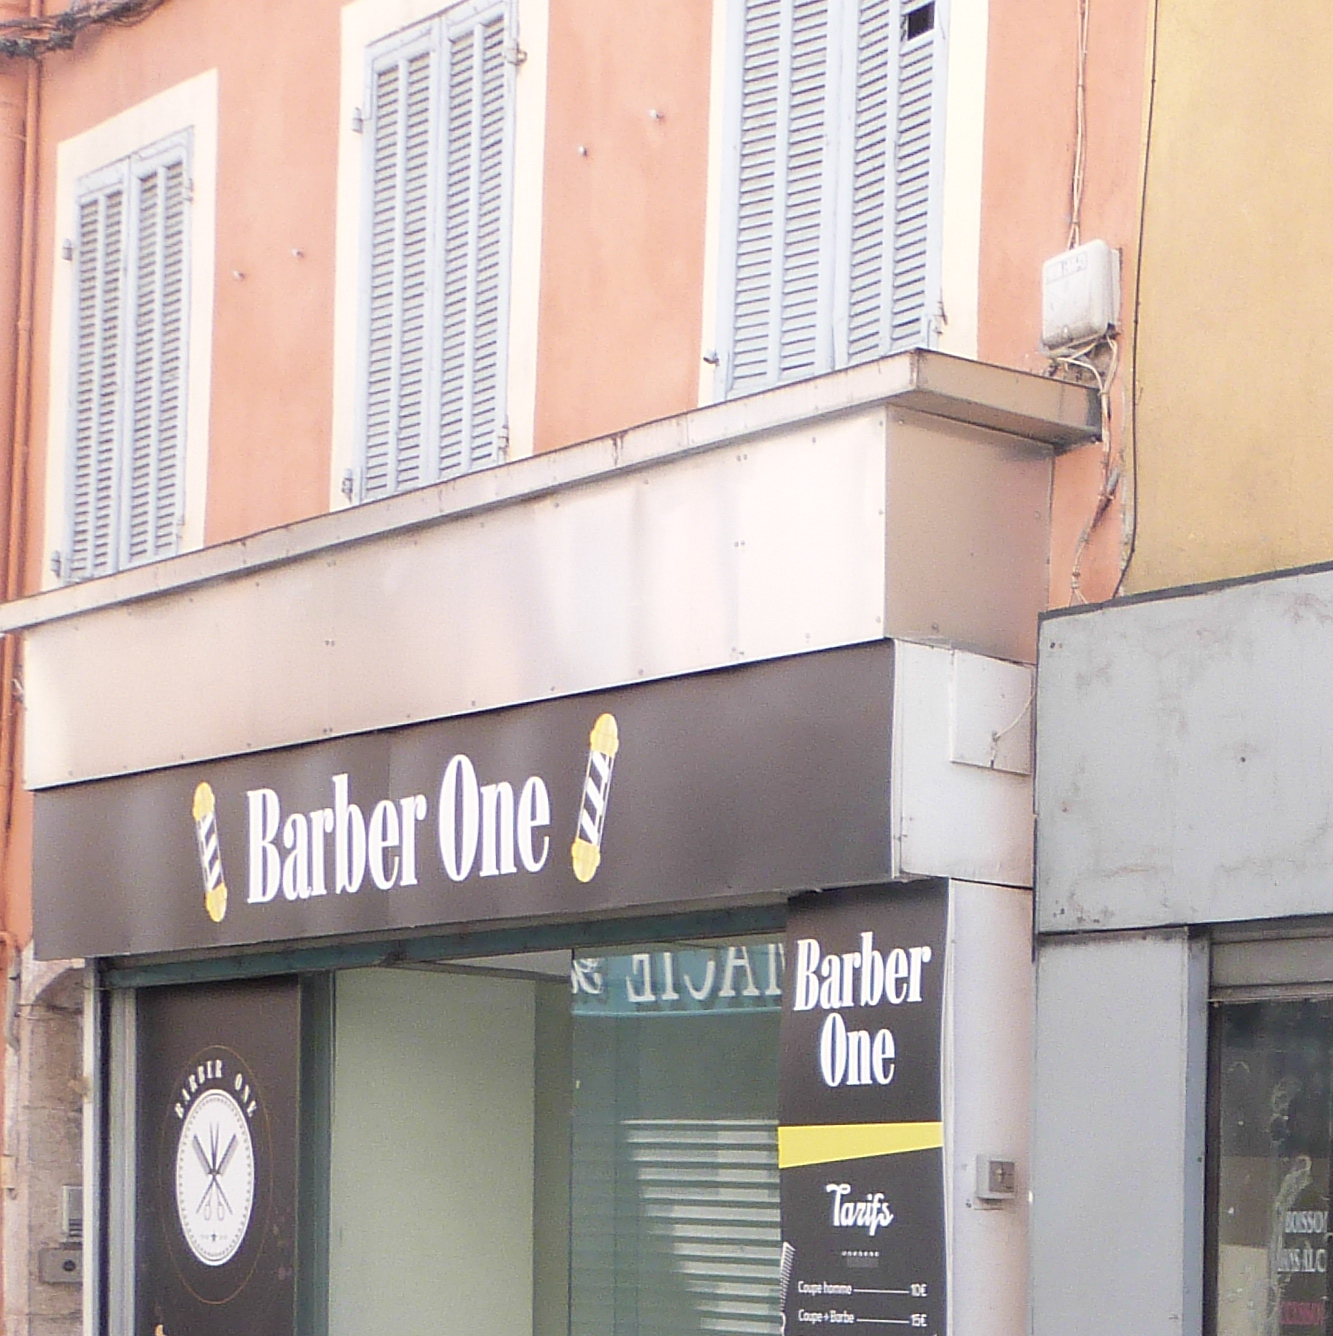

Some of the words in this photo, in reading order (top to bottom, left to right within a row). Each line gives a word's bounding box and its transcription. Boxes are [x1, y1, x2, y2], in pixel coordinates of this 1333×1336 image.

[246, 773, 427, 904] Barber
[438, 754, 551, 882] One
[793, 931, 932, 1012] Barber
[820, 1011, 896, 1088] One
[826, 1183, 894, 1236] Tarifs
[797, 1280, 822, 1297] Coupe
[823, 1280, 853, 1295] homme
[910, 1283, 928, 1297] 10€
[797, 1308, 822, 1325] Coupe
[829, 1309, 855, 1324] Barbe
